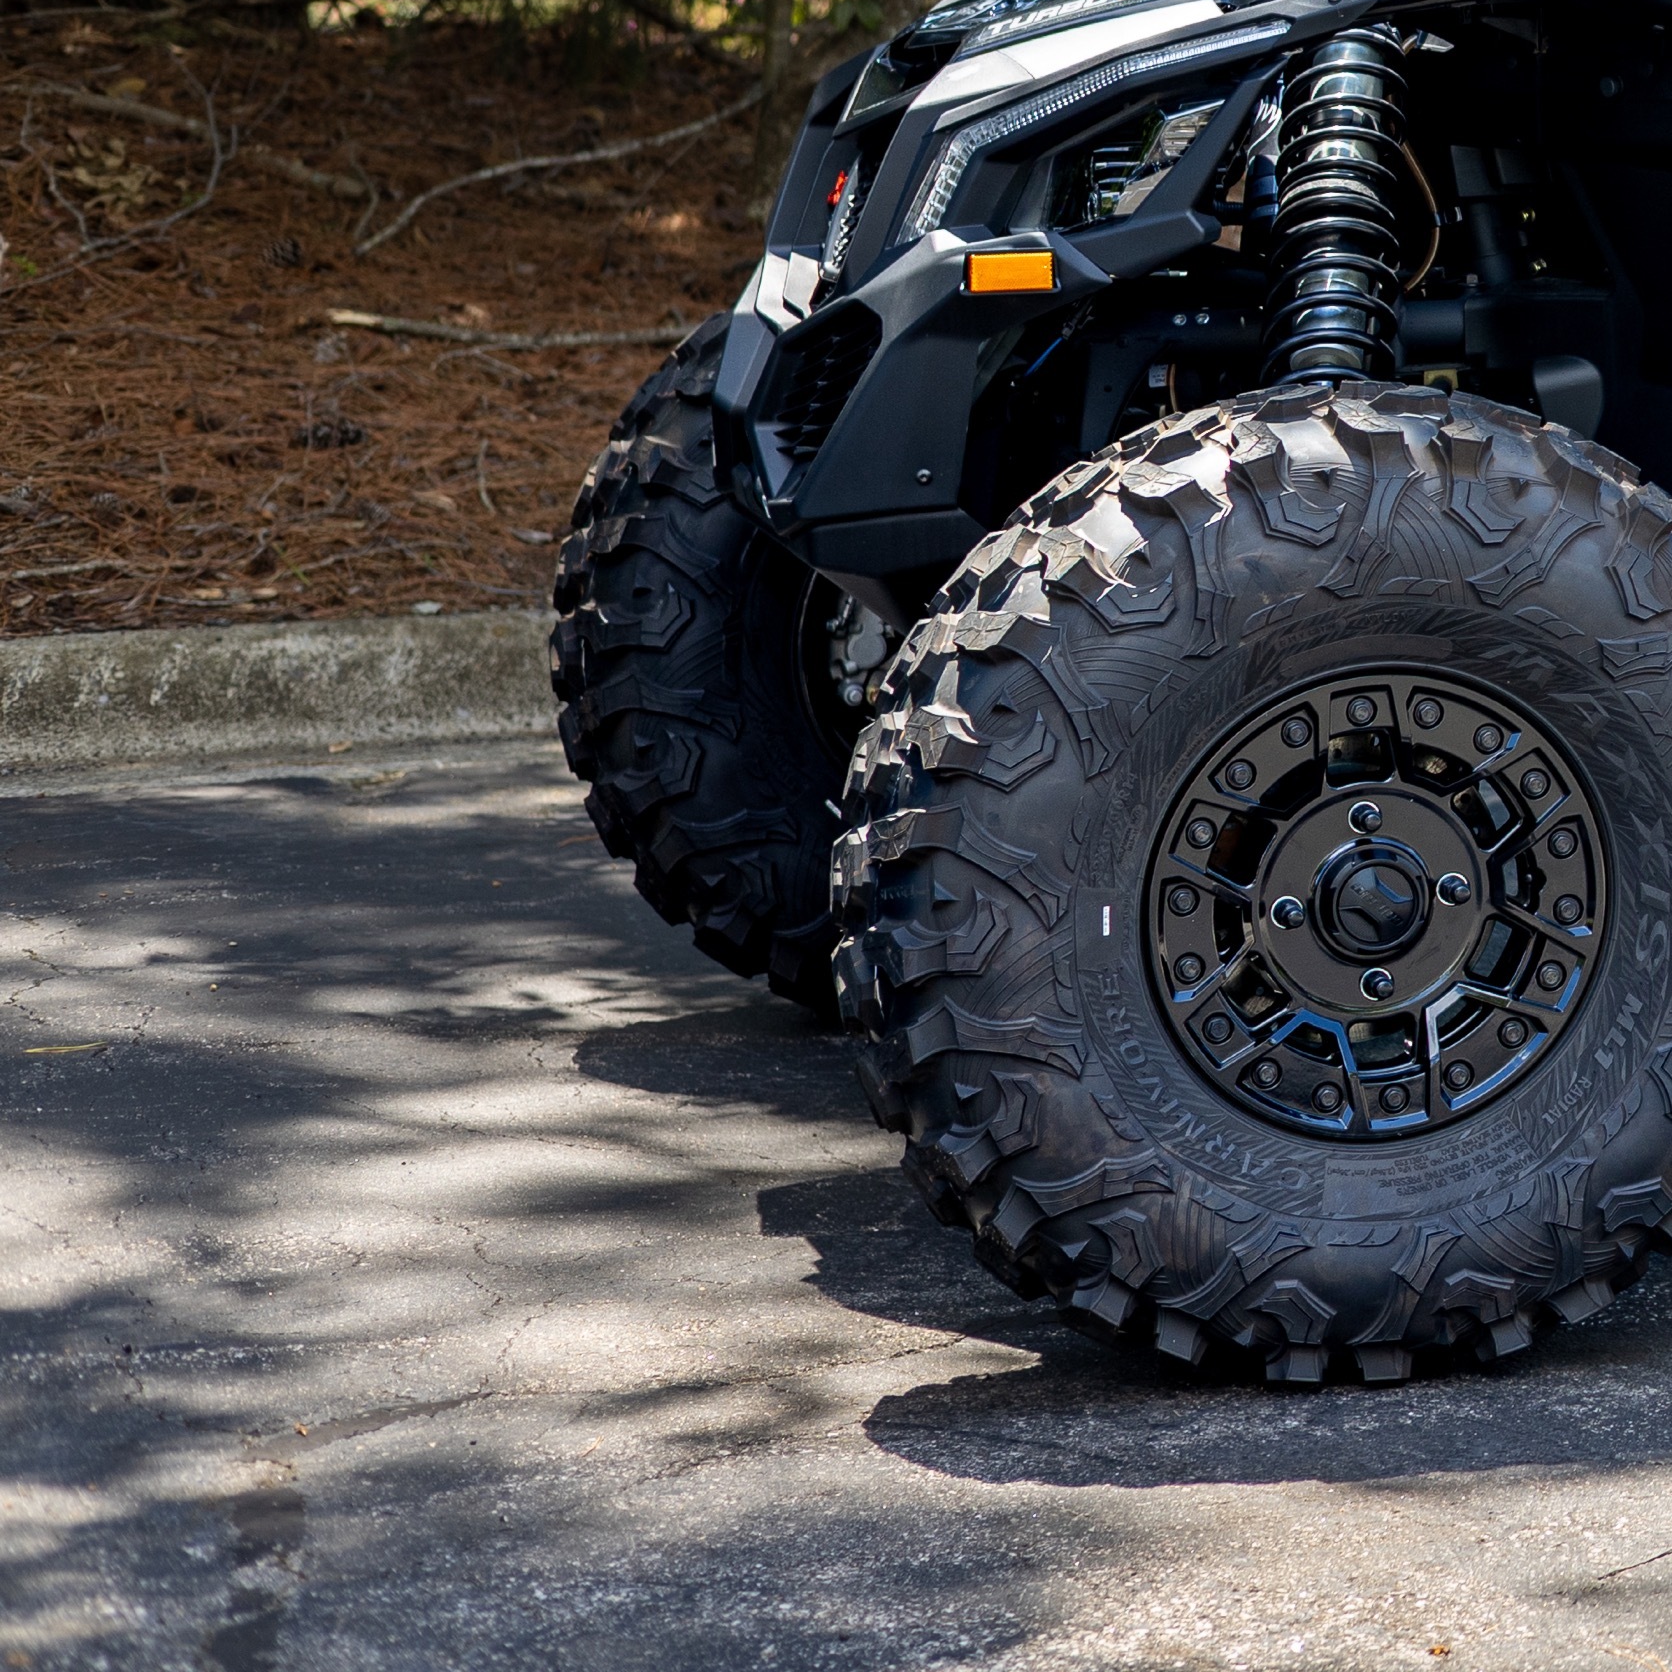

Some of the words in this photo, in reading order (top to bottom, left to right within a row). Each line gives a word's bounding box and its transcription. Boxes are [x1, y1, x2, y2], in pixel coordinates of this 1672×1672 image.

[1590, 991, 1646, 1072] ML1
[1084, 966, 1313, 1199] CARNIVORE
[1538, 1072, 1593, 1128] RADIAL
[1422, 1159, 1471, 1182] OPERATING
[1471, 1150, 1490, 1165] FOR
[1477, 1150, 1512, 1174] VEHICLE
[1493, 1151, 1537, 1182] WARNING
[1449, 1167, 1477, 1184] LABEL
